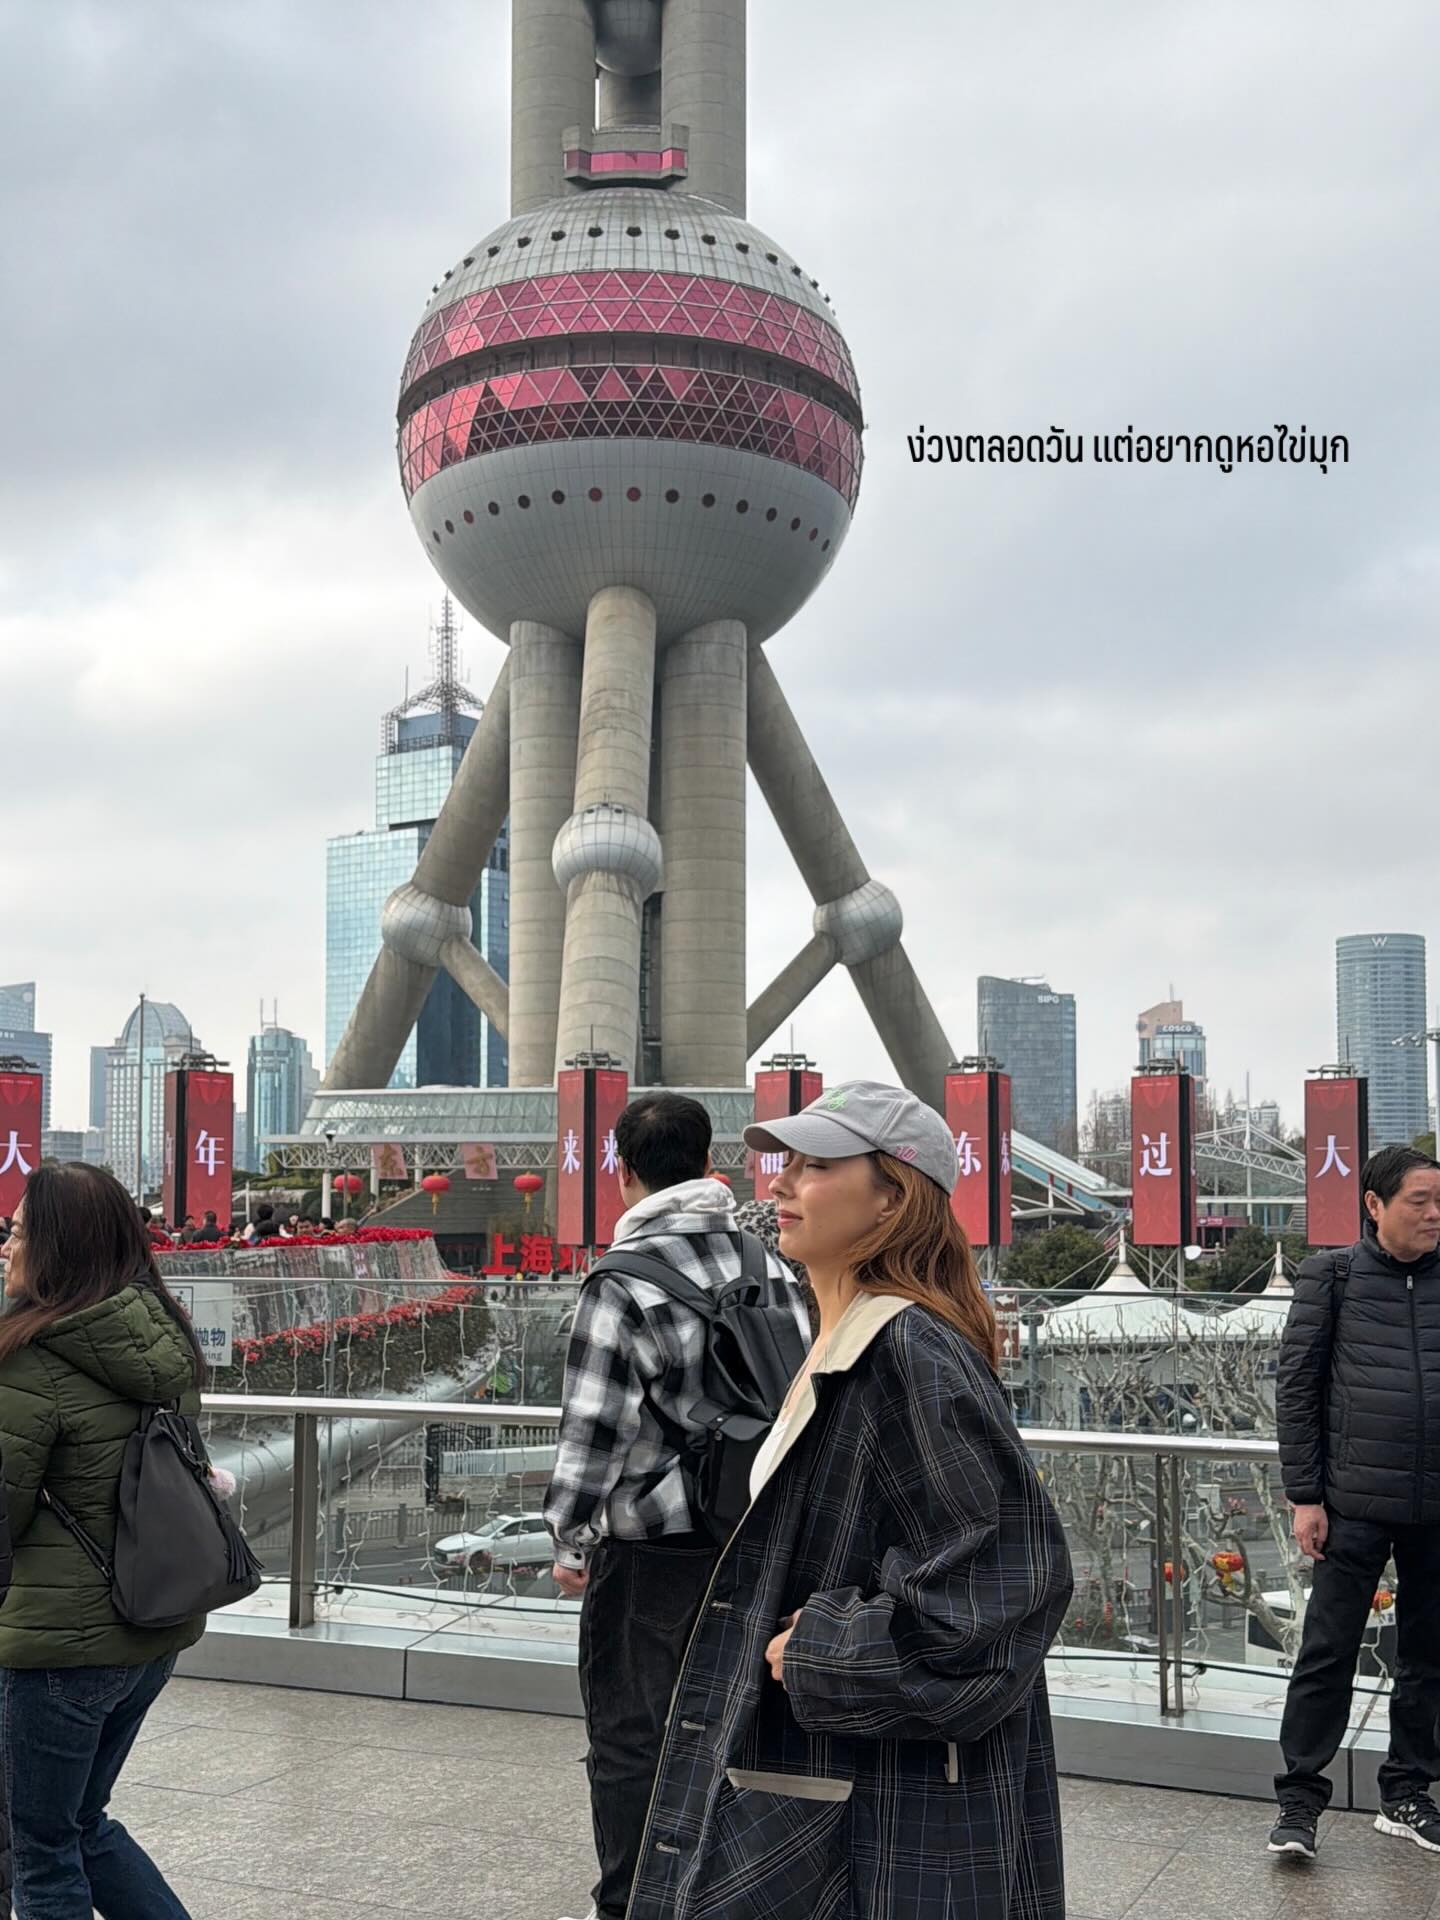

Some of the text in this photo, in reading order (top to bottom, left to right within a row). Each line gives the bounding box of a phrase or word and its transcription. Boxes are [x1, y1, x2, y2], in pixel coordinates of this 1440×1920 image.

[1371, 936, 1388, 947] W
[0, 1131, 32, 1176] 大
[195, 1129, 226, 1177] 年
[561, 1128, 581, 1175] 来
[954, 1130, 982, 1176] 东
[1138, 1131, 1173, 1177] 过
[1314, 1134, 1351, 1178] 大
